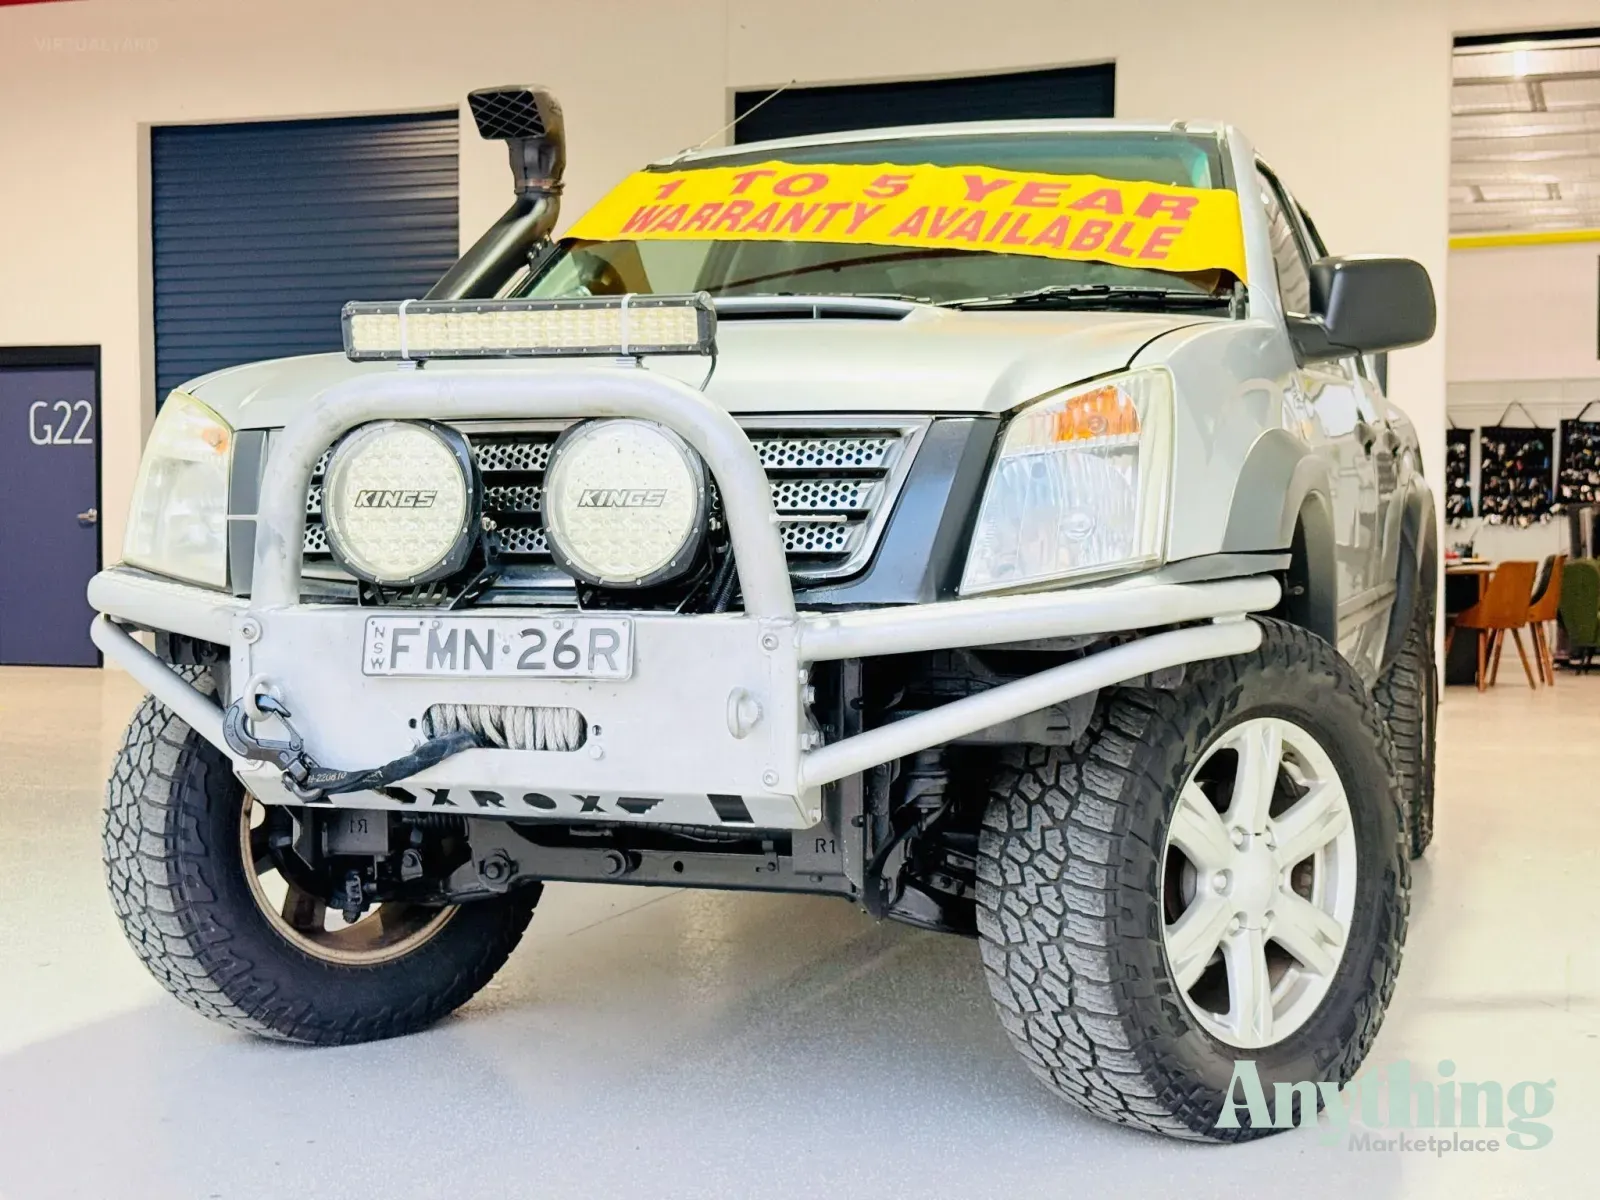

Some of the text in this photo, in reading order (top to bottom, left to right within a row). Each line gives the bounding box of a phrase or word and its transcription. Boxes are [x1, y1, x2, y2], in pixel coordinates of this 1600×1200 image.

[655, 170, 1200, 221] 1 TO 5 YEAR
[619, 199, 1184, 260] WARRANTY AVAILABLE
[29, 400, 93, 446] G22
[354, 489, 438, 509] KINGS
[576, 488, 668, 508] KINGS
[815, 838, 836, 854] R1
